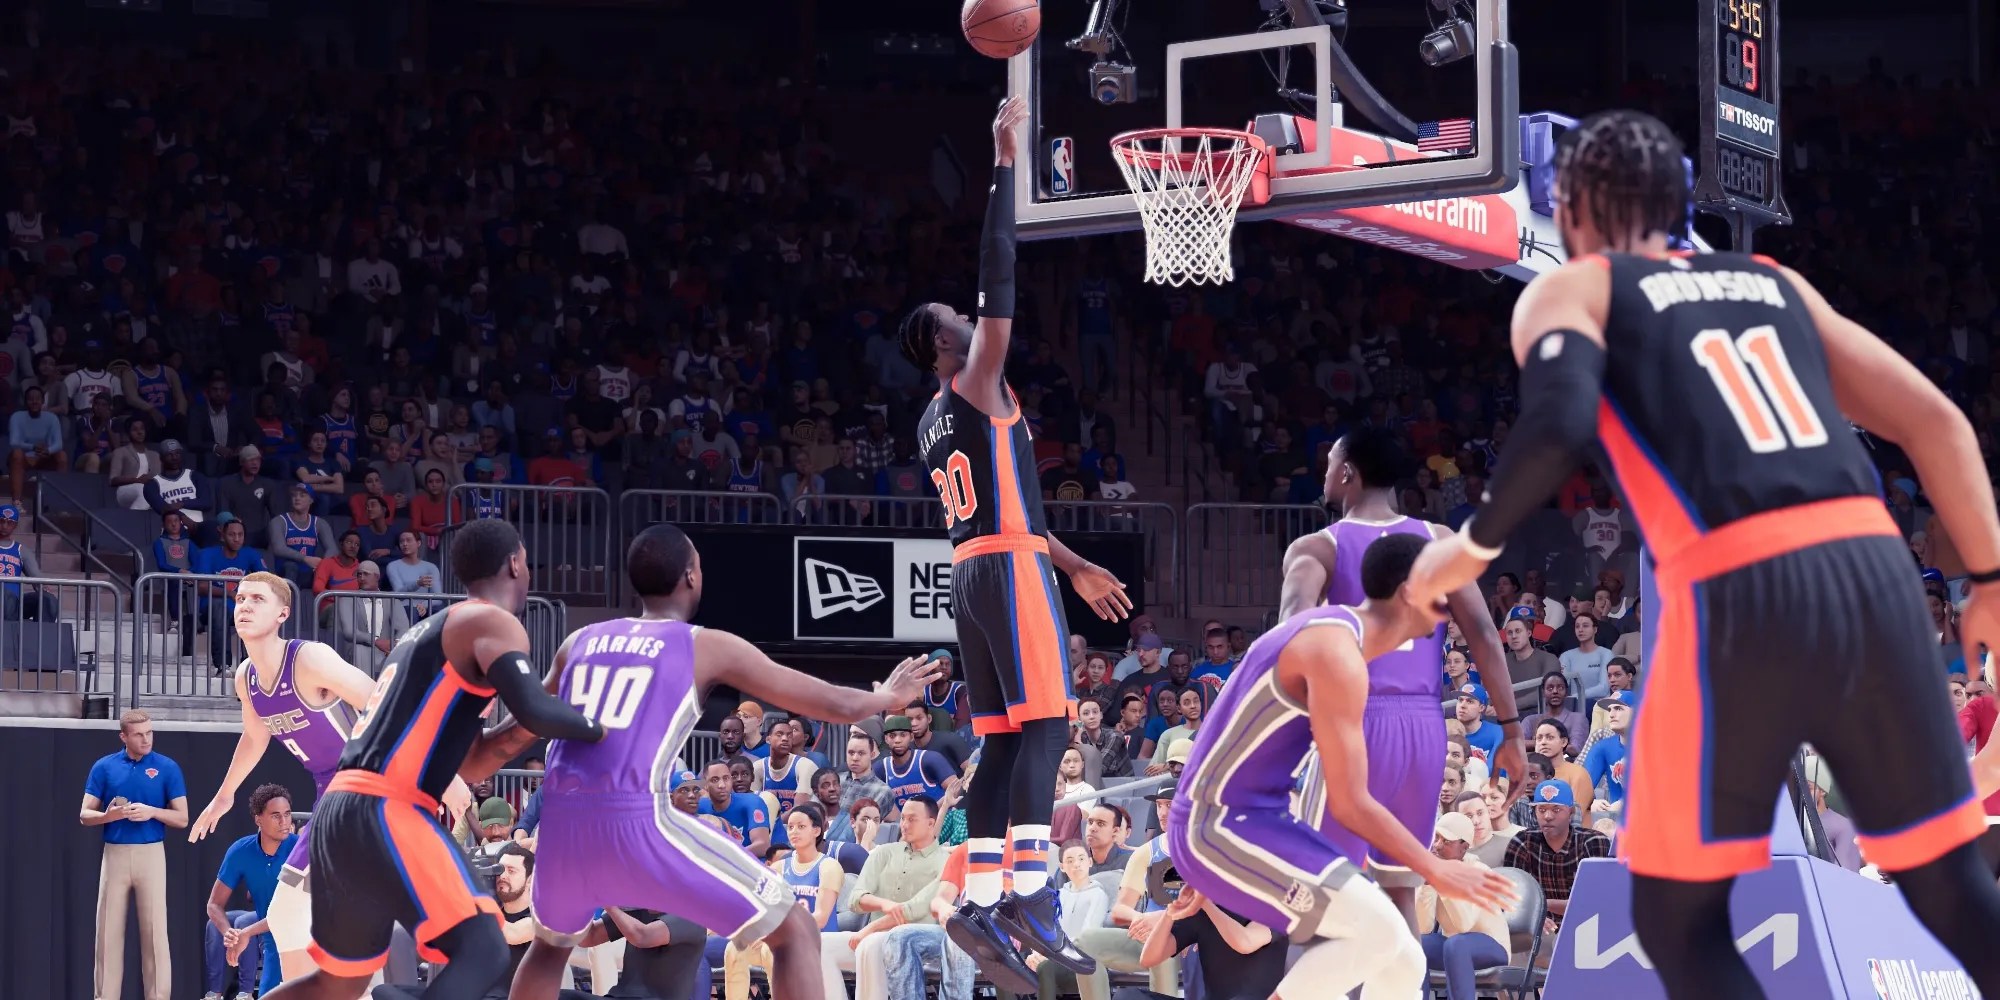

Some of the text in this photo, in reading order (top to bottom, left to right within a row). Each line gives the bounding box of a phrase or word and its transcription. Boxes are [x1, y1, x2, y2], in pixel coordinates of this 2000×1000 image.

[1742, 40, 1758, 91] 9
[1734, 107, 1775, 136] TISSOT
[1690, 324, 1829, 453] 11
[161, 486, 194, 499] KINGS
[931, 449, 977, 529] 30
[585, 634, 665, 659] BARNES
[570, 662, 655, 730] 40
